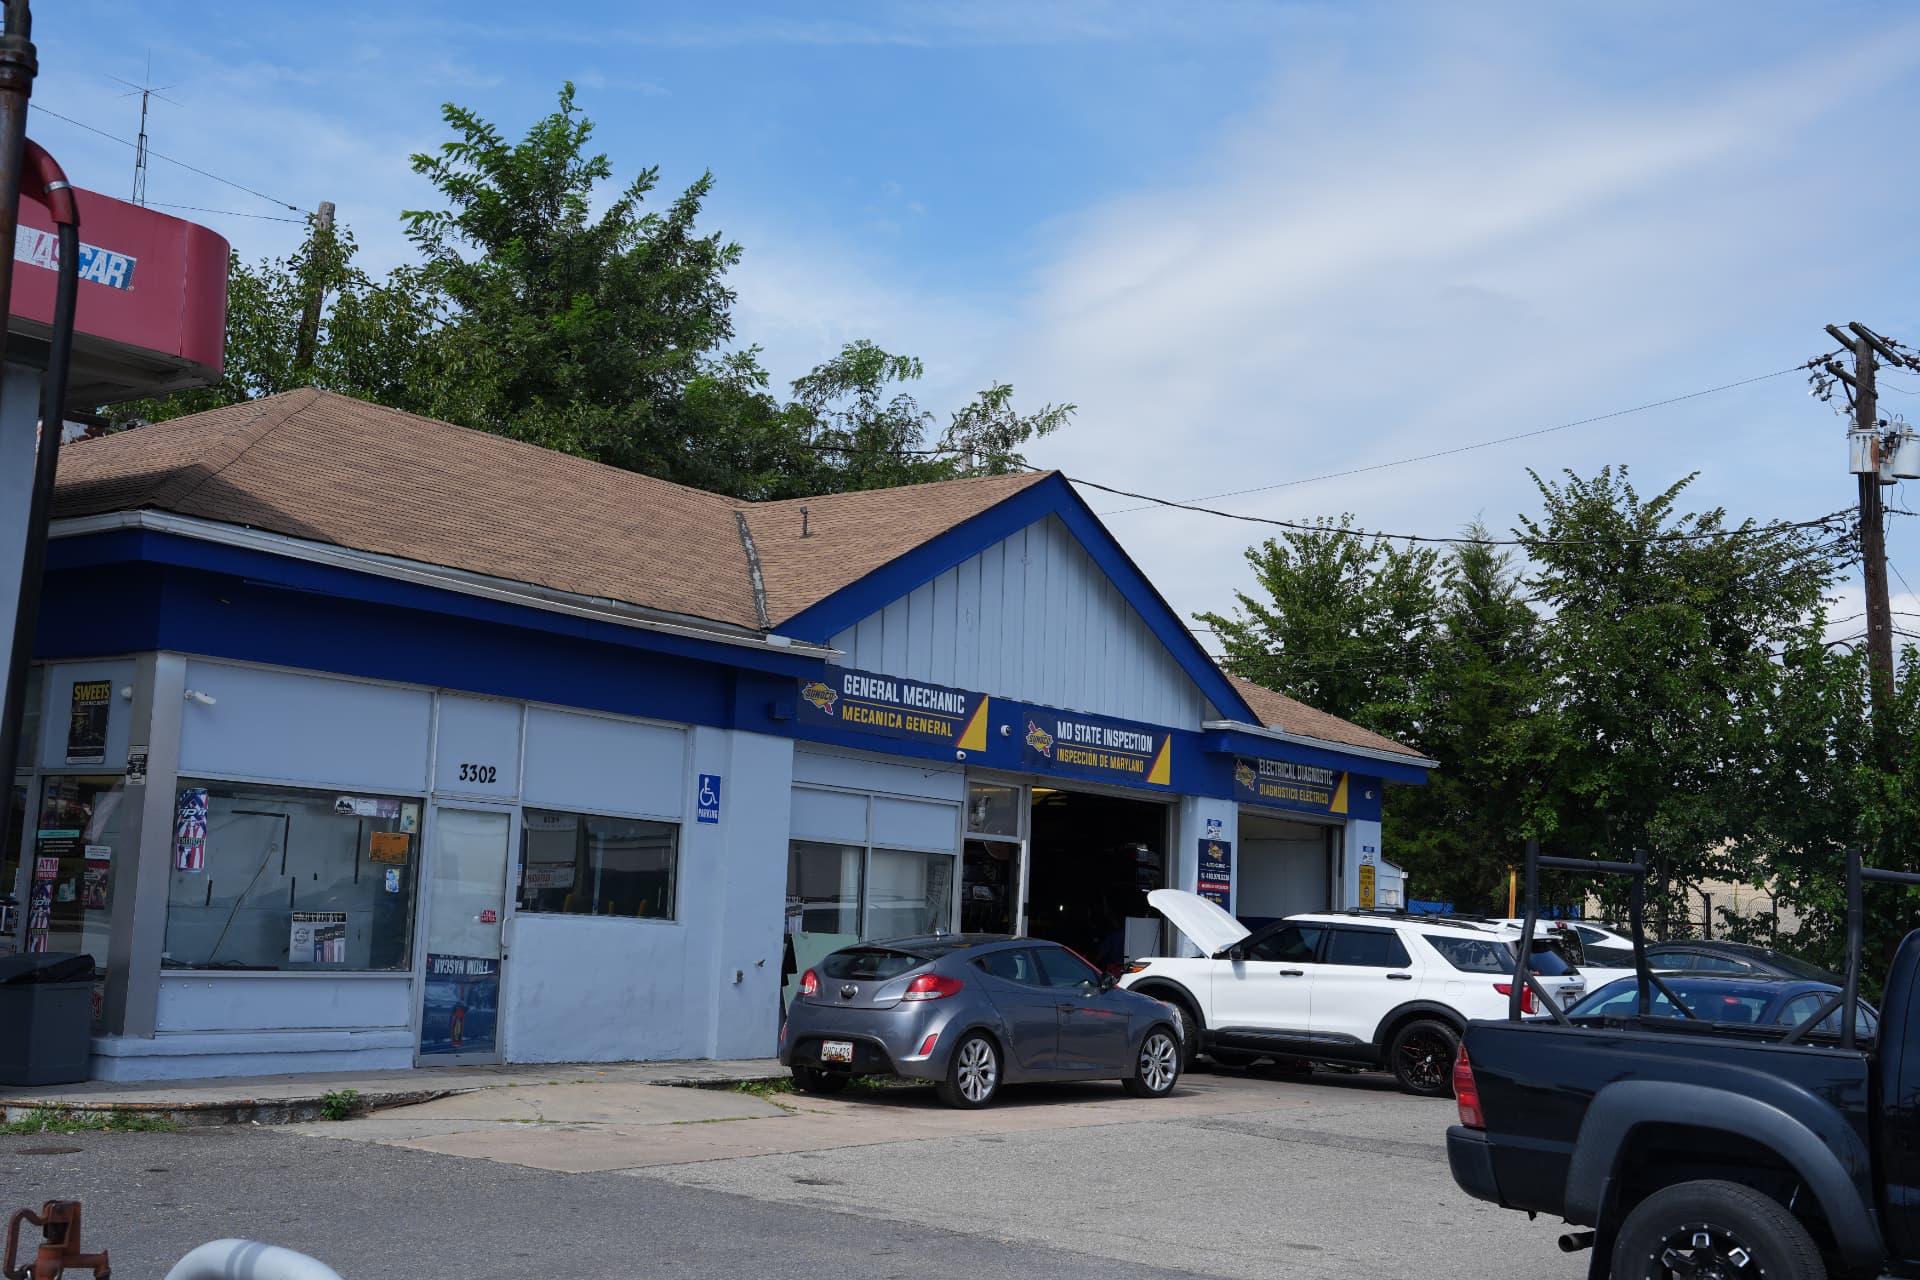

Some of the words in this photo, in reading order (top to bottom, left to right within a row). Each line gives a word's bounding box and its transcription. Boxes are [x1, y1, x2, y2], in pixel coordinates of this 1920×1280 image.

[74, 684, 110, 701] SWEETS
[843, 674, 900, 703] GENERAL
[903, 684, 965, 714] MECHANIC
[842, 704, 902, 729] MECANICA
[905, 715, 953, 737] GENERAL
[1057, 721, 1073, 740] MD
[1074, 724, 1102, 745] STATE
[1103, 728, 1153, 753] INSPECTION
[459, 763, 497, 784] 3302
[1099, 754, 1109, 768] DE
[1109, 755, 1144, 773] MARYLAND
[1258, 759, 1297, 779] ELECTRICAL
[1297, 764, 1333, 785] DIAGNOSTIC
[39, 858, 59, 871] ATM
[434, 959, 464, 975] NASCAR
[466, 960, 489, 975] FROM
